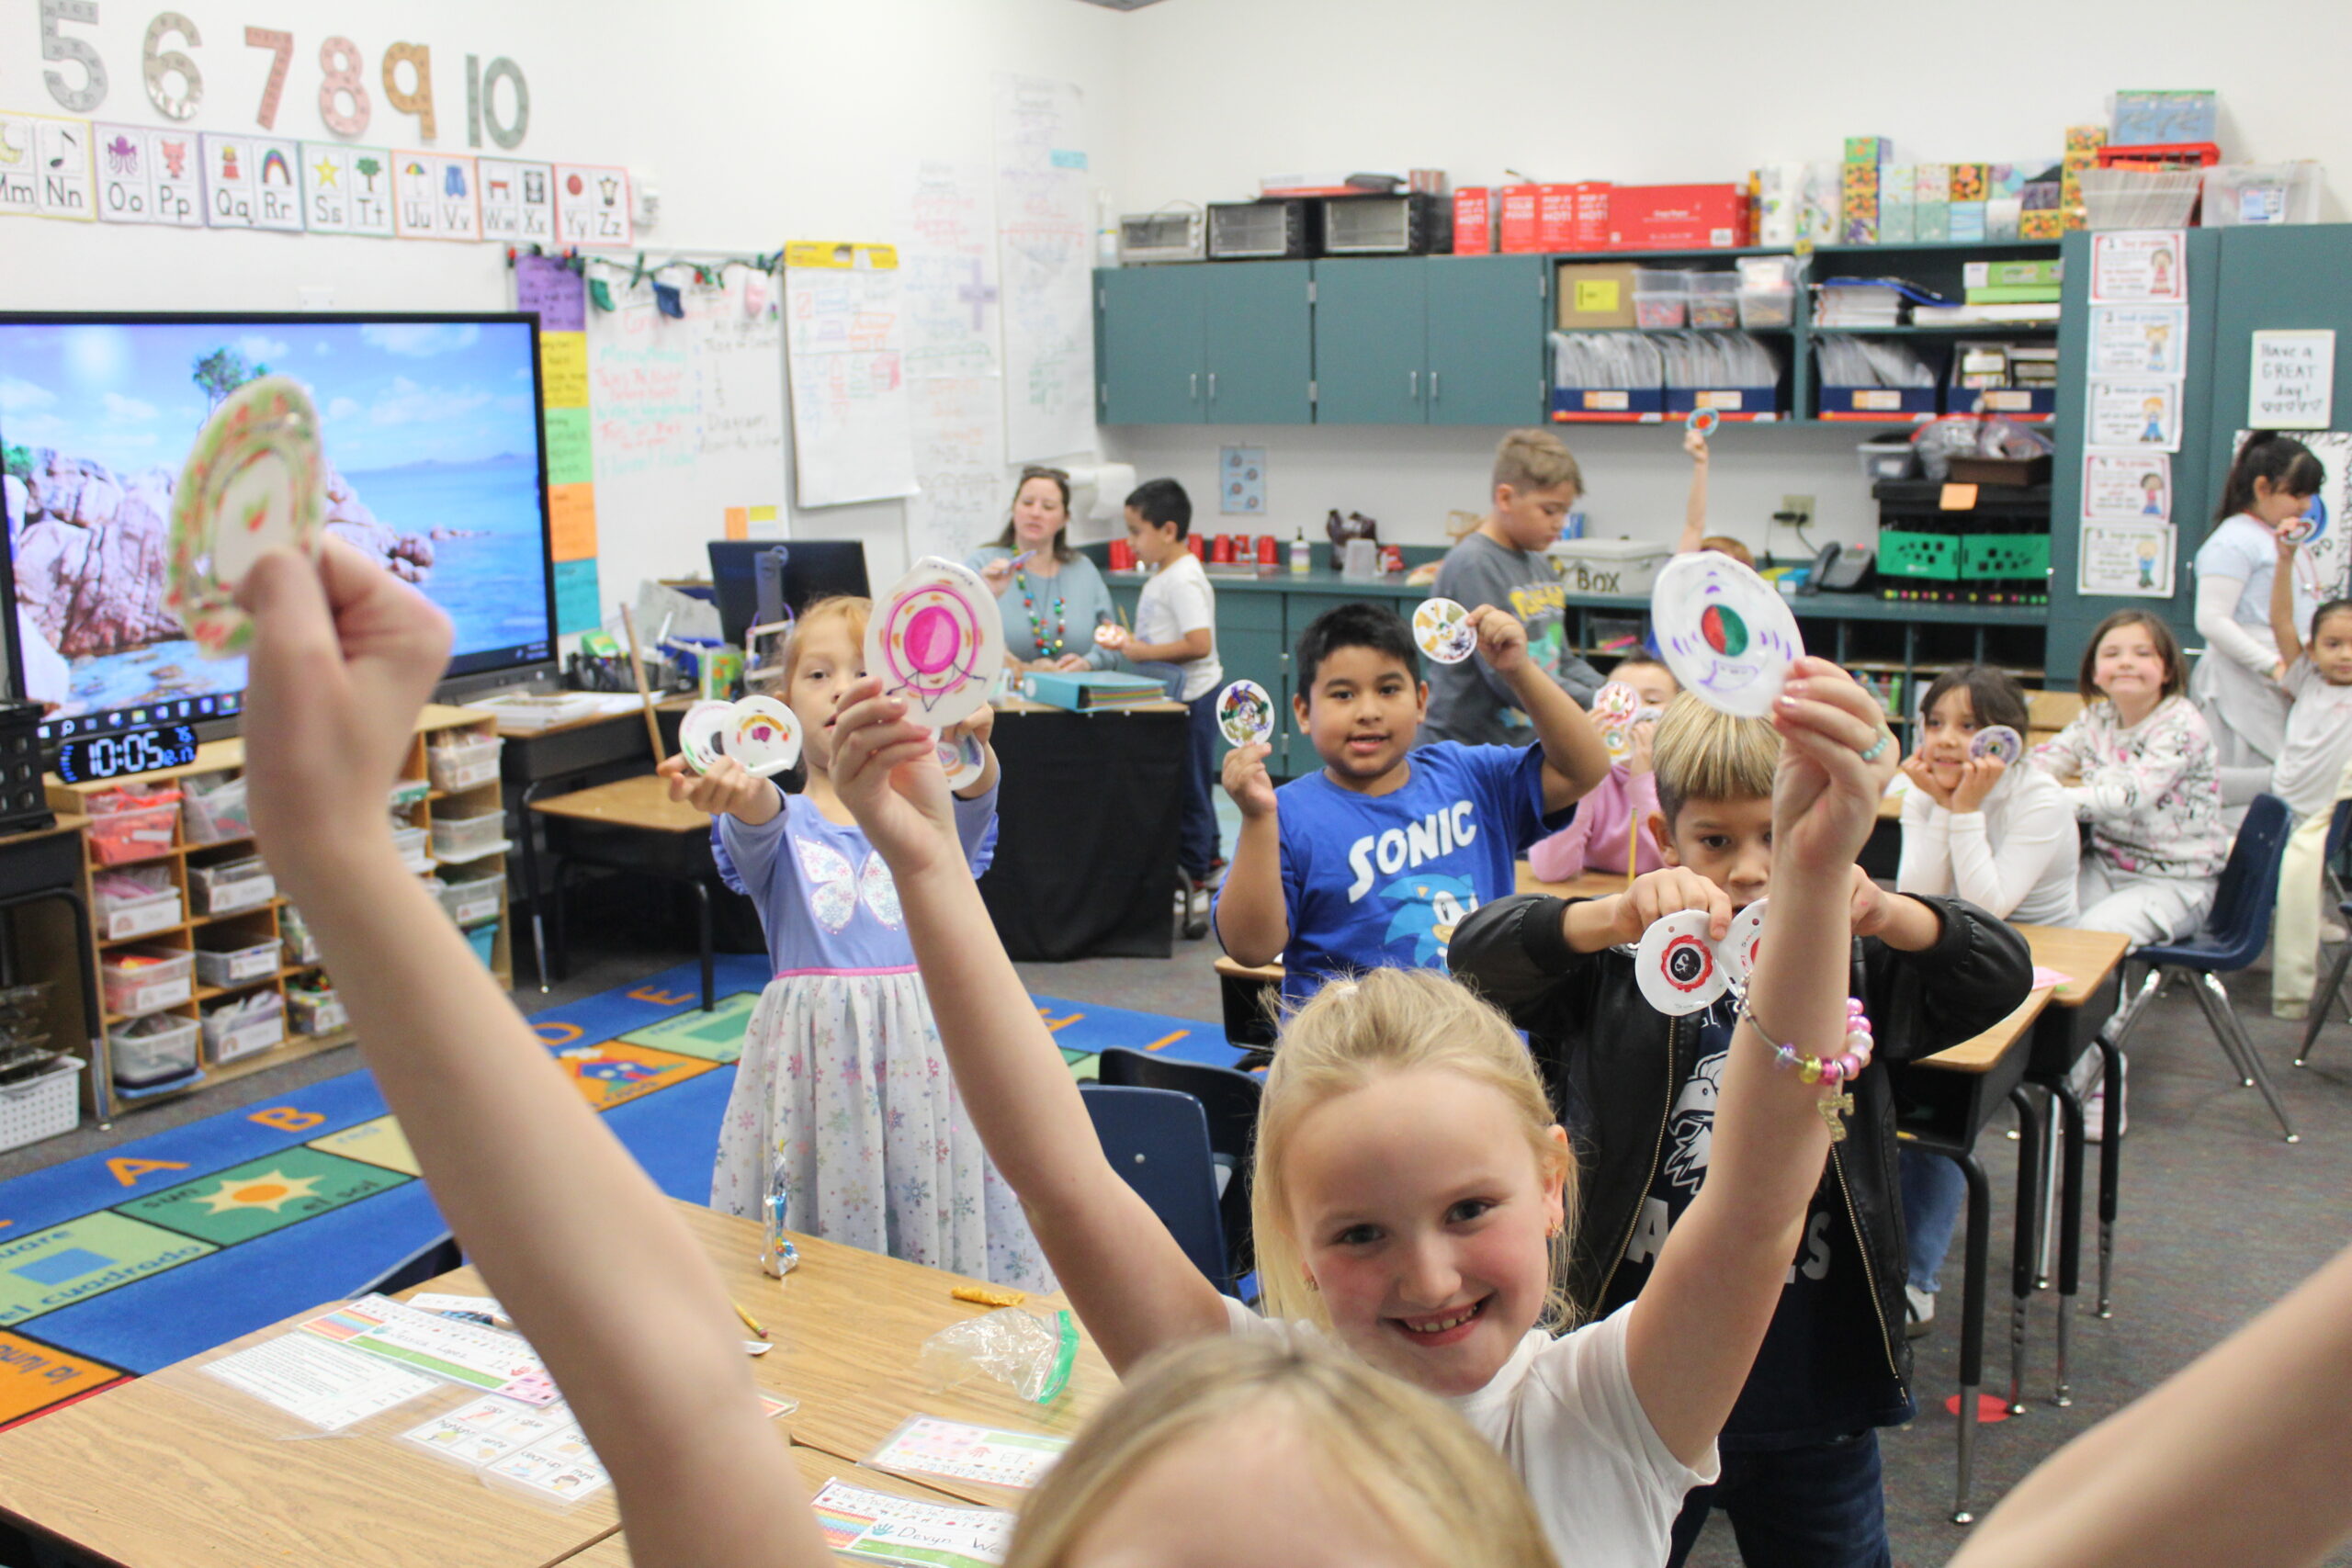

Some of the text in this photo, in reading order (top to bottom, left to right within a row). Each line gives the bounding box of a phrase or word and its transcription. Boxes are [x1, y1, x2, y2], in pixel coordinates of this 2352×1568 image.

[39, 0, 530, 150] 5 6 7 8 9 10
[47, 175, 83, 207] Nn
[108, 182, 142, 211] Oo
[160, 186, 190, 220] Pp
[217, 188, 254, 225] Qq
[265, 192, 290, 219] Rr
[315, 196, 342, 223] Ss
[357, 197, 384, 226] Tt
[404, 201, 431, 229] Uu
[524, 209, 545, 233] Xx
[598, 212, 621, 236] Zz
[2261, 344, 2296, 357] Have
[2262, 362, 2317, 378] GREAT
[88, 731, 164, 777] 10:05
[1348, 800, 1477, 904] SONIC
[247, 1106, 326, 1132] B
[106, 1156, 190, 1187] A
[41, 1246, 201, 1305] cuadrado
[897, 1527, 952, 1545] Devyn
